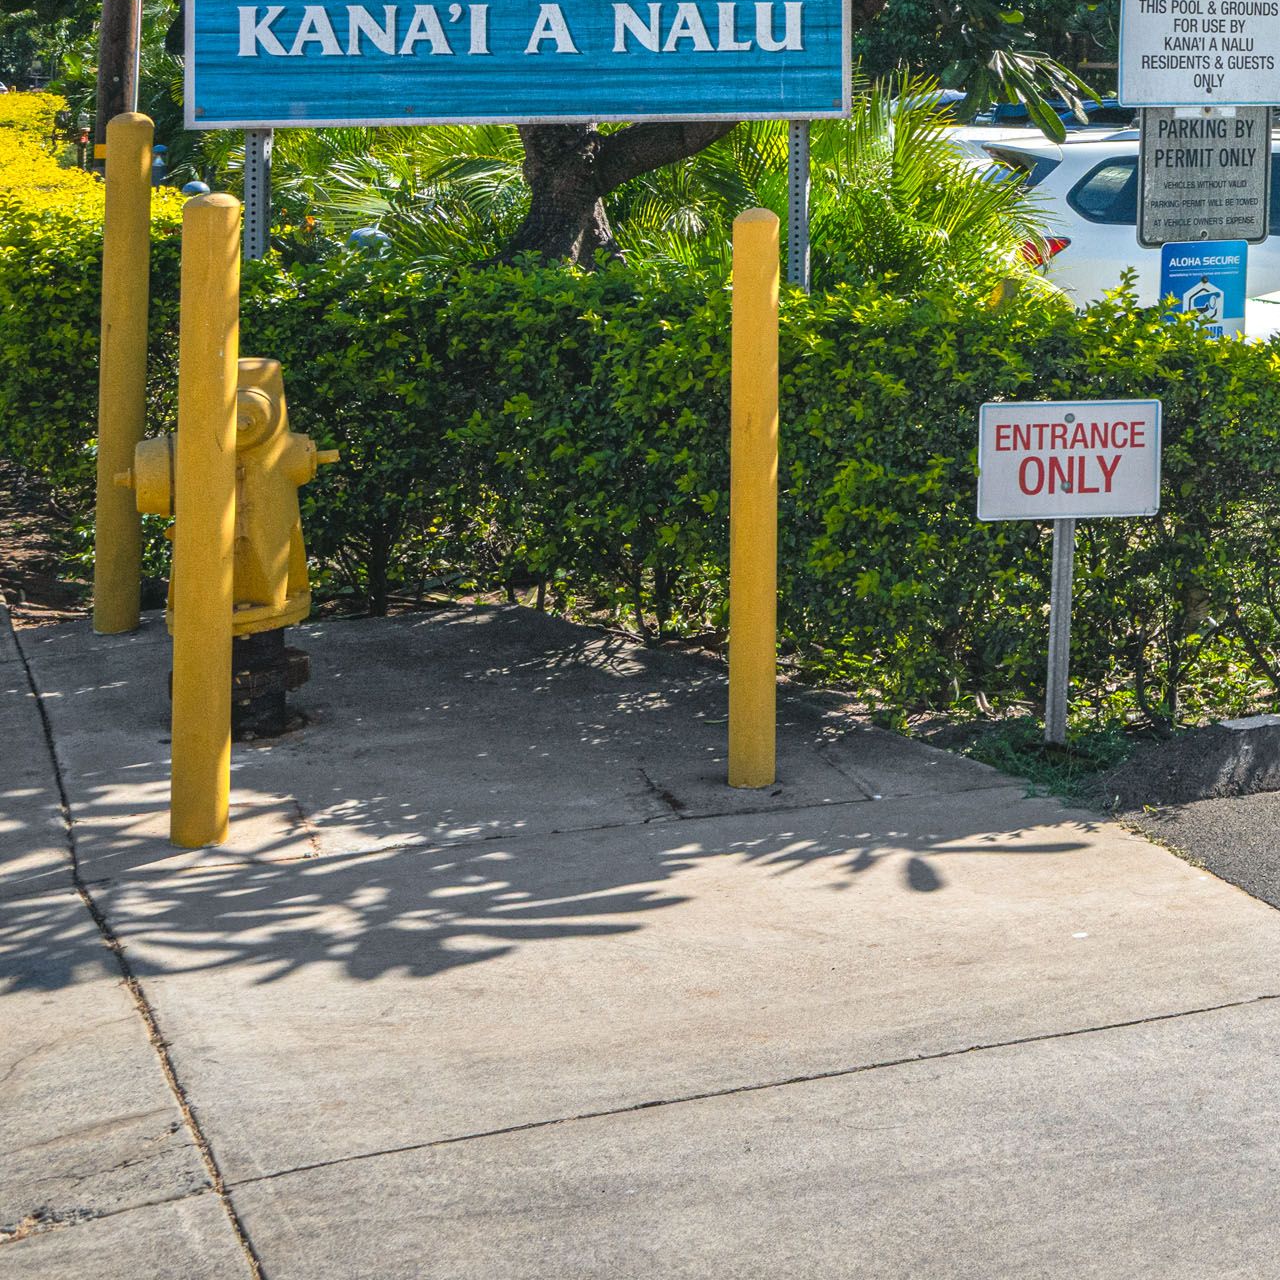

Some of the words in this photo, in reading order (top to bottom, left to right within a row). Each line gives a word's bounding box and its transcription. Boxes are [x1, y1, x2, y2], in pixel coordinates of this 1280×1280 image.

[1139, 0, 1167, 14] THIS
[1171, 0, 1203, 15] POOL
[1207, 1, 1217, 15] &
[1221, 1, 1279, 16] GROUNDS
[236, 3, 491, 57] KANA'I
[524, 3, 581, 55] A
[611, 1, 804, 53] NALU
[1173, 18, 1198, 33] FOR
[1202, 19, 1226, 34] USE
[1230, 20, 1246, 34] BY
[1164, 37, 1205, 51] KANA'I
[1208, 37, 1218, 51] A
[1221, 38, 1254, 52] NALU
[1141, 55, 1211, 70] RESIDENTS
[1214, 56, 1223, 70] &
[1227, 56, 1275, 70] GUESTS
[1193, 73, 1225, 89] ONLY
[1158, 119, 1227, 139] PARKING
[1234, 119, 1255, 139] BY
[1154, 148, 1214, 168] PERMIT
[1219, 148, 1257, 168] ONLY
[1163, 180, 1196, 190] VEHICLES
[1197, 180, 1227, 189] WITHOUT
[1228, 180, 1247, 188] VALID
[1150, 200, 1180, 209] PARKING
[1182, 199, 1206, 208] PERMIT
[1208, 199, 1223, 207] WILL
[1225, 198, 1234, 207] BE
[1236, 197, 1259, 206] TOWED
[1153, 219, 1162, 227] AT
[1163, 218, 1192, 227] VEHICLE
[1193, 217, 1223, 226] OWNER'S
[1225, 216, 1255, 225] EXPENSE
[1168, 257, 1201, 267] ALOHA
[1202, 255, 1240, 266] SECURE
[995, 421, 1146, 451] ENTRANCE
[1018, 455, 1122, 496] ONLY
